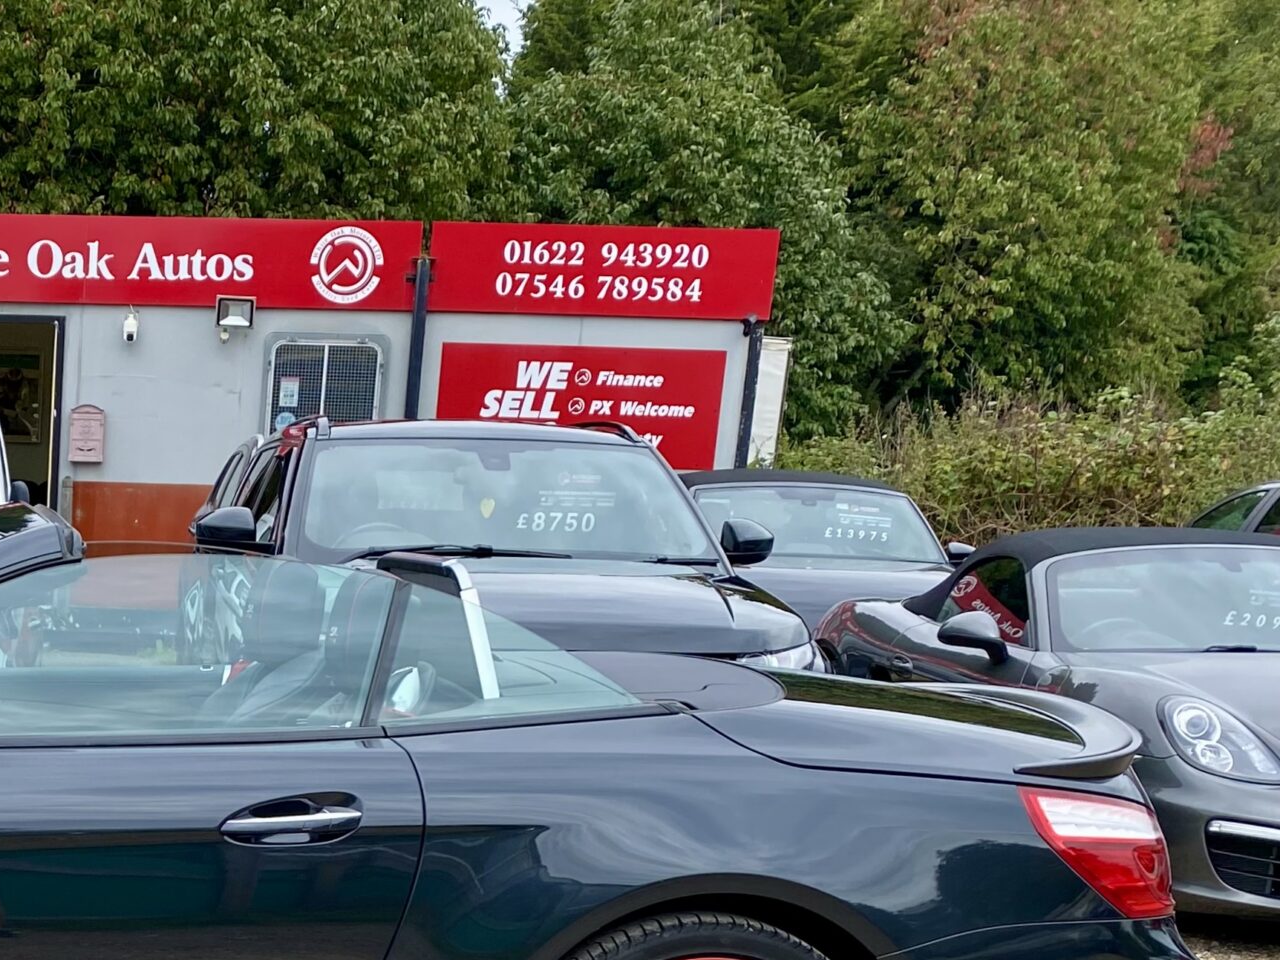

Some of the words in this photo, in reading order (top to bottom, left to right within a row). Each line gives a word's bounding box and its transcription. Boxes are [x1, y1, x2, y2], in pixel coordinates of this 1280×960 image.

[26, 238, 116, 282] Oak
[127, 241, 255, 283] Autos
[503, 239, 586, 267] 01622
[601, 243, 710, 269] 943920
[495, 271, 586, 299] 07546
[597, 275, 703, 303] 789584
[515, 360, 574, 391] WE
[595, 370, 665, 389] Finance
[478, 389, 562, 421] SELL
[589, 400, 614, 417] PX
[620, 400, 696, 419] Welcome
[516, 511, 596, 533] £8750
[824, 526, 888, 543] £13975
